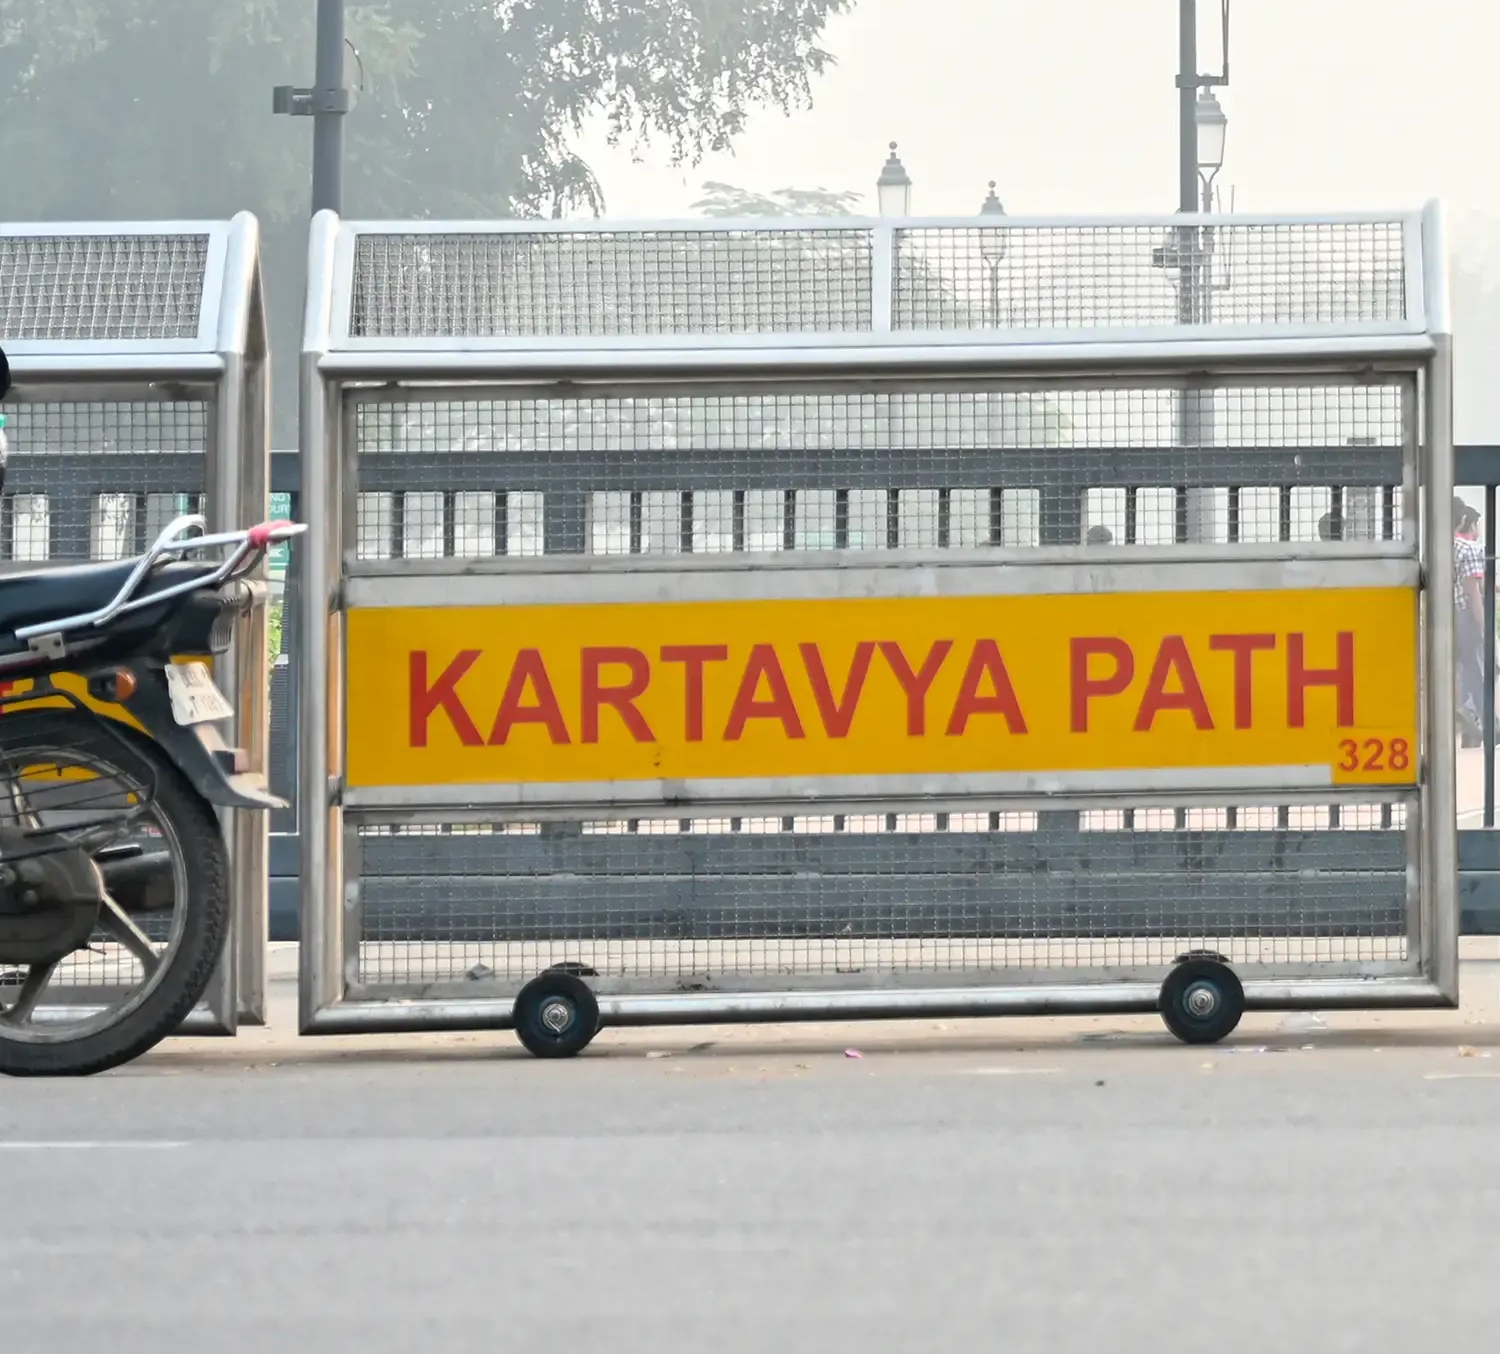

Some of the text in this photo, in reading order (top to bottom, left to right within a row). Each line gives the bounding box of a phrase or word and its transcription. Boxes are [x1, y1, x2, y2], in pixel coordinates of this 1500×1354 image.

[409, 631, 1355, 748] KARTAVYA PATH
[1337, 737, 1410, 773] 328
